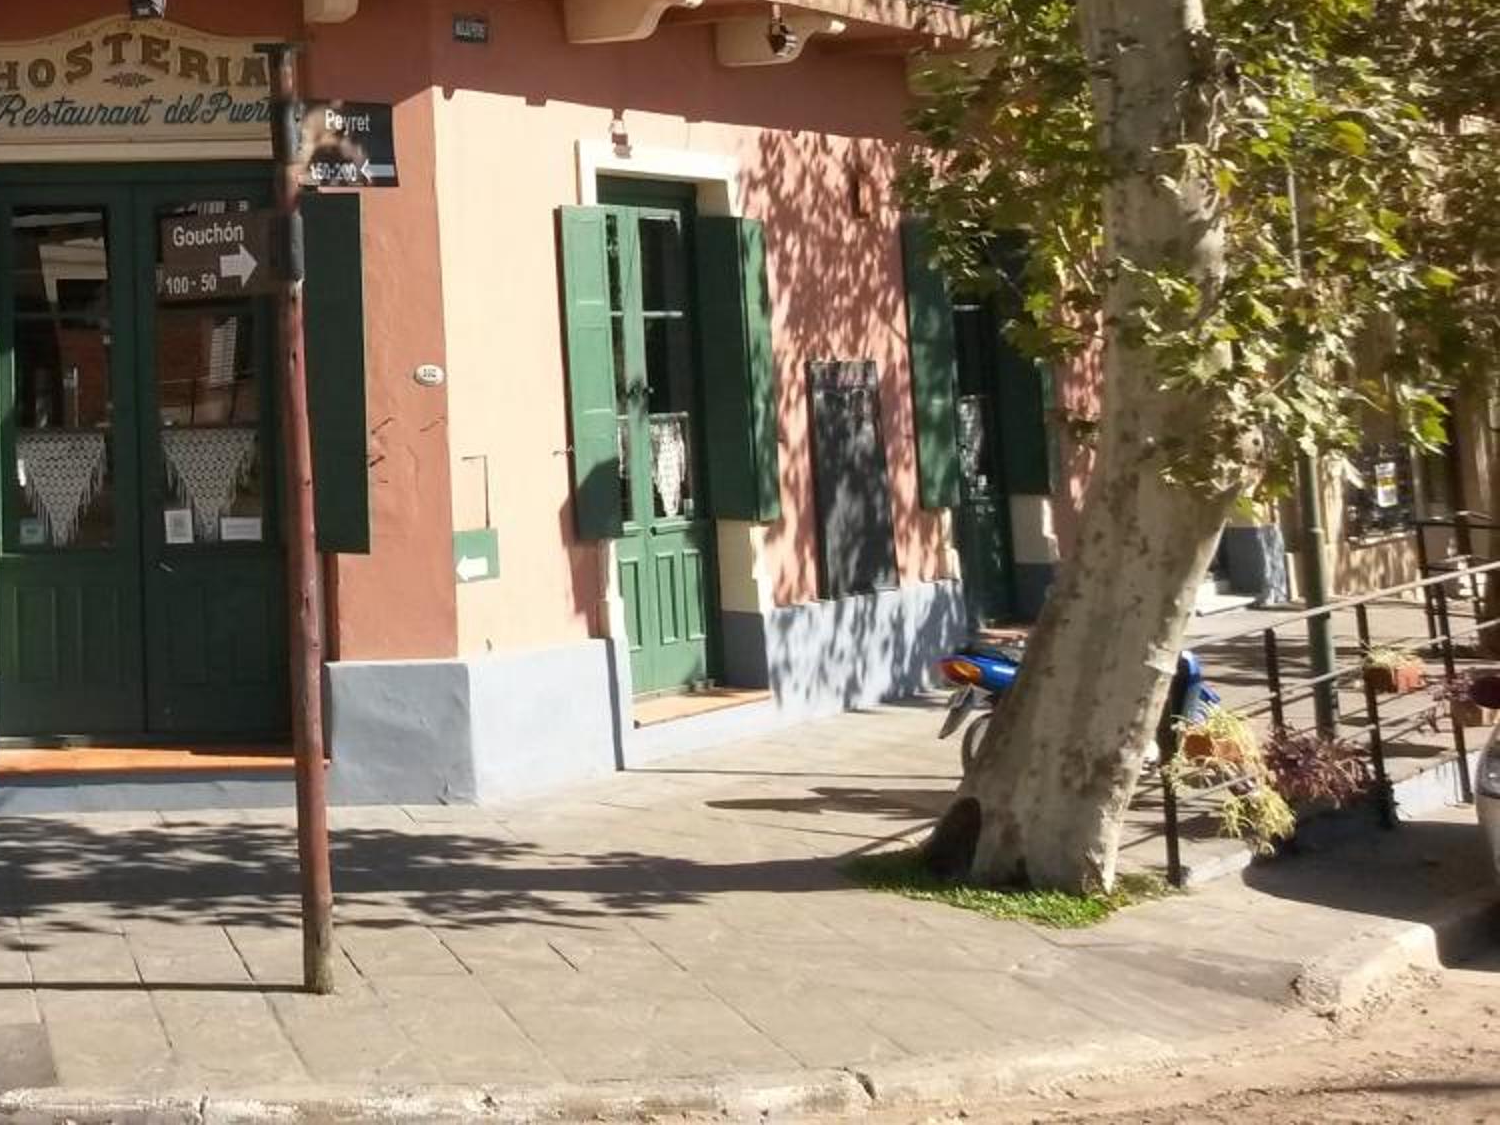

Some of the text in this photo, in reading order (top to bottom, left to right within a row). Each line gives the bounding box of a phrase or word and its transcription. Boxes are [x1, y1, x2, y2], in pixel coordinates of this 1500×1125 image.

[164, 93, 199, 125] del
[200, 90, 273, 127] Puert
[324, 108, 372, 136] Peyret
[172, 220, 245, 248] Gouchón
